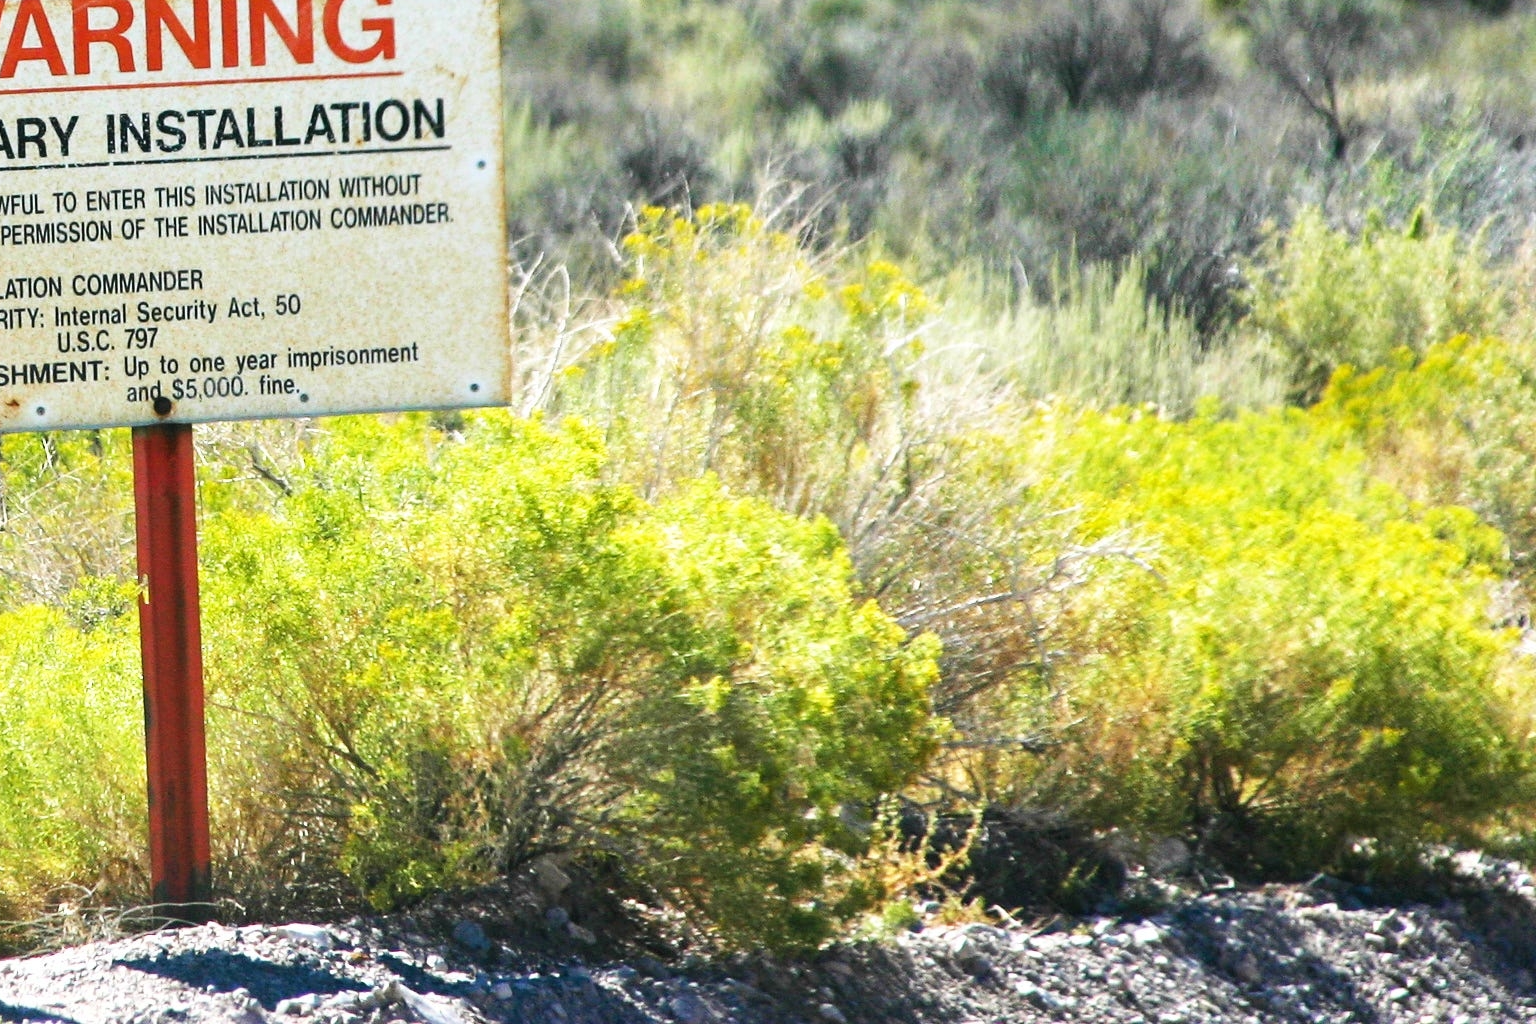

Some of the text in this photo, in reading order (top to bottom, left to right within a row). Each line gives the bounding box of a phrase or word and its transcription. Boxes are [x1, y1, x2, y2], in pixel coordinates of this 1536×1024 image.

[107, 98, 446, 154] INSTALLATION
[53, 191, 77, 214] TO
[86, 188, 145, 212] ENTER
[155, 185, 195, 208] THIS
[205, 179, 330, 206] INSTALLATION
[339, 174, 422, 199] WITHOUT
[1, 220, 113, 246] PERMISSION
[121, 218, 145, 240] OF
[155, 216, 188, 238] THE
[198, 209, 322, 236] INSTALLATION
[330, 202, 454, 230] COMMANDER.
[72, 270, 203, 296] COMMANDER
[55, 303, 127, 326] Internal
[137, 300, 217, 324] Security
[228, 297, 265, 320] Act,
[275, 294, 301, 316] 50
[57, 328, 158, 353] U.S.C. 797
[124, 356, 149, 380] Up
[160, 356, 179, 375] to
[189, 356, 225, 374] one
[236, 353, 277, 375] year
[287, 342, 419, 368] imprisonment
[127, 375, 301, 402] and $5,000. fine.
